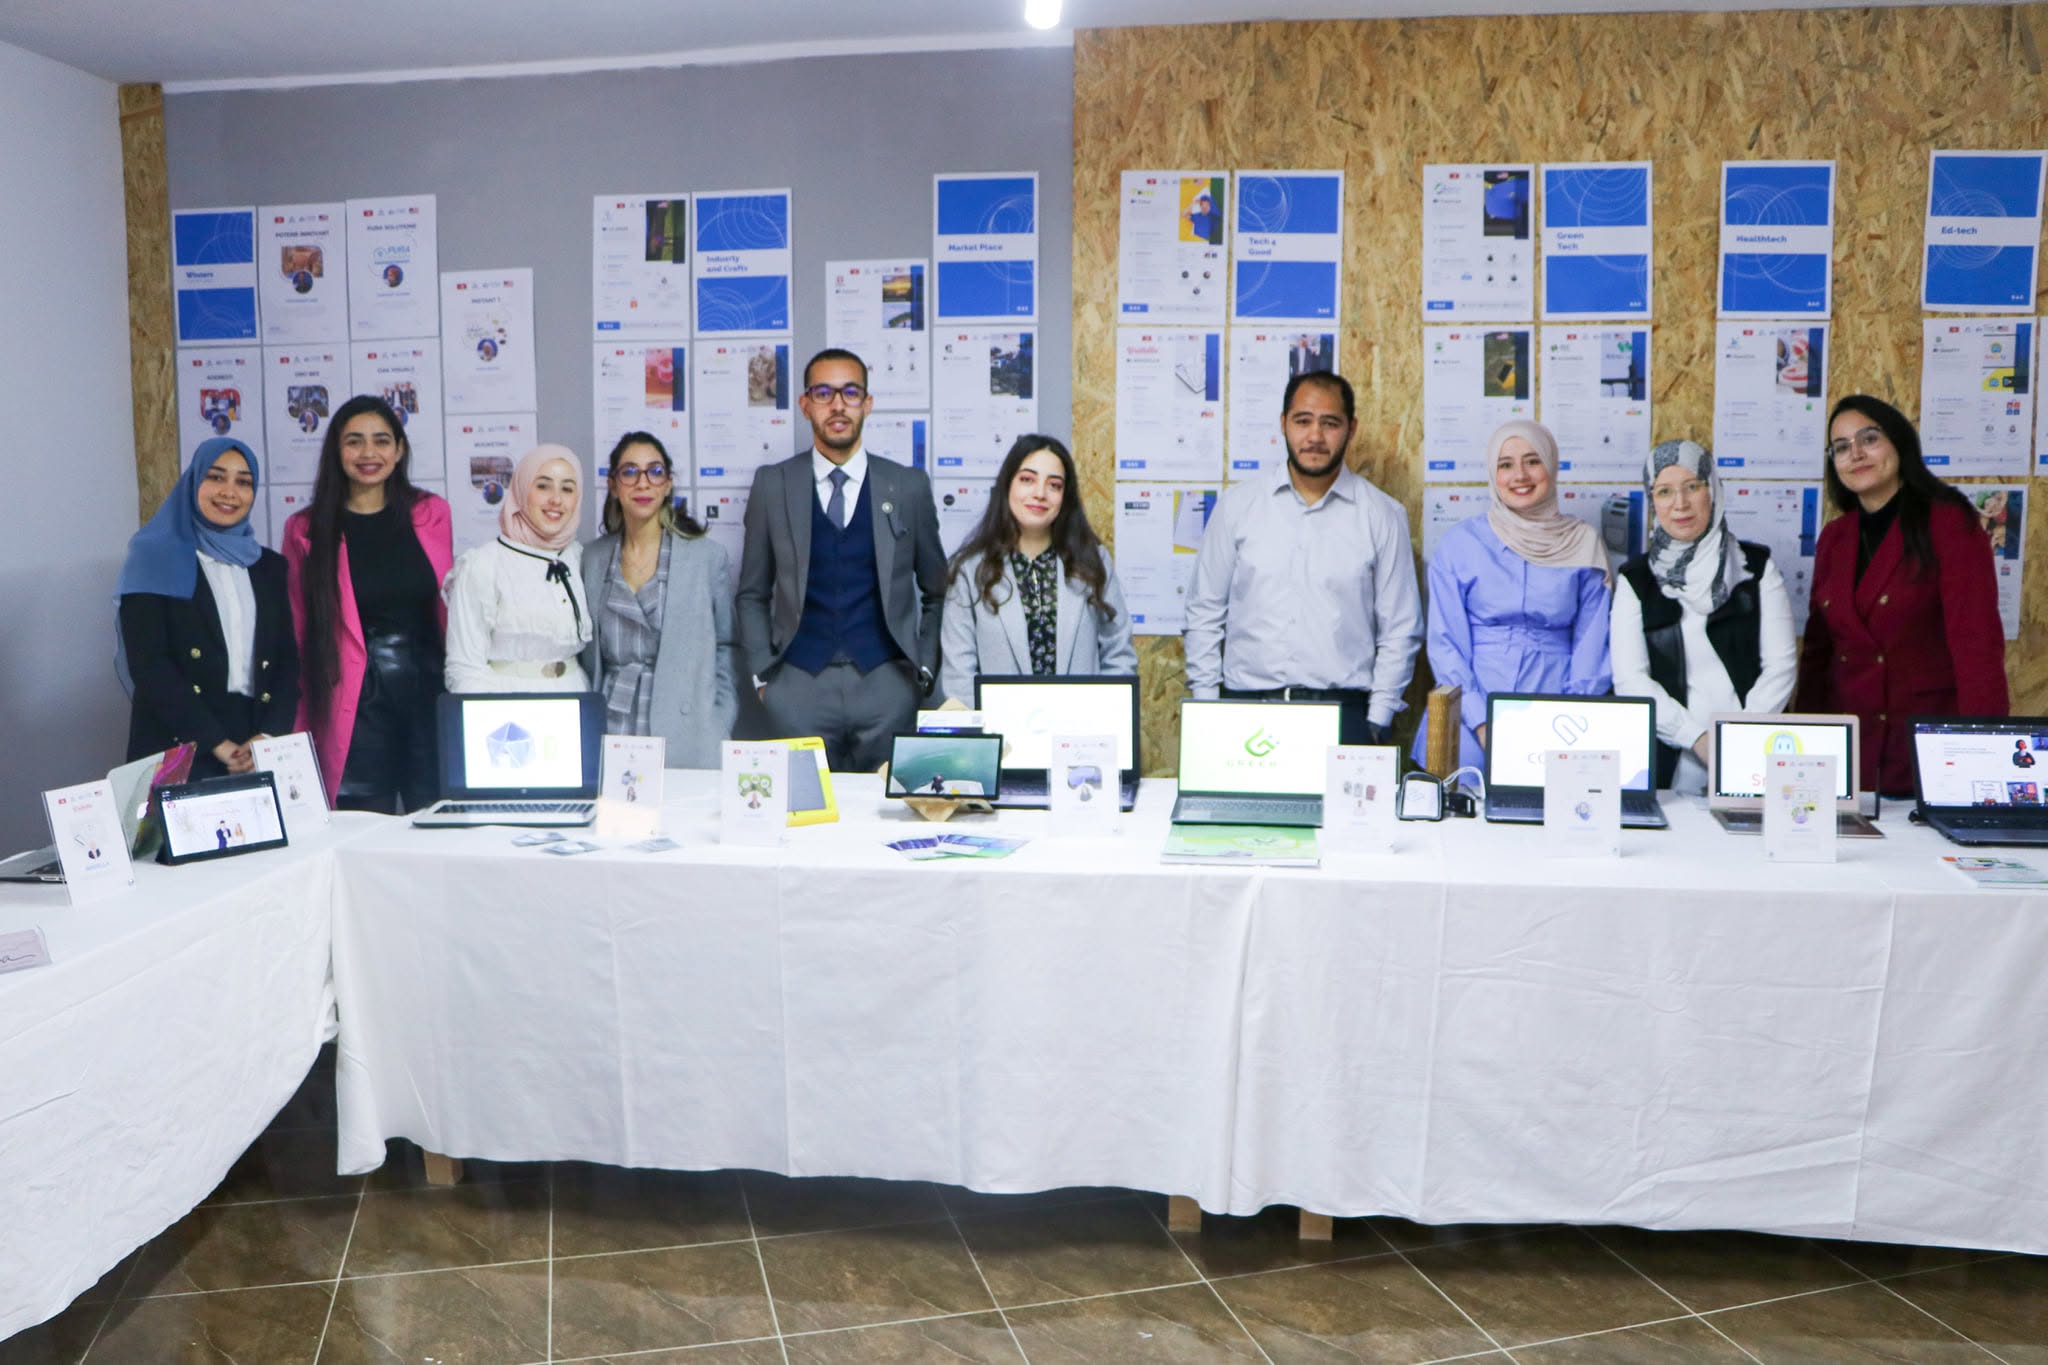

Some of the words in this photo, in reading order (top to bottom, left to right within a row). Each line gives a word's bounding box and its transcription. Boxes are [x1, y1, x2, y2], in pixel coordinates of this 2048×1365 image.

[1941, 226, 1977, 235] Ed-tech
[1249, 237, 1270, 245] Tech
[1736, 235, 1787, 243] Healthtech
[948, 243, 977, 251] Market
[979, 243, 1003, 251] Place
[724, 264, 748, 272] Crafts
